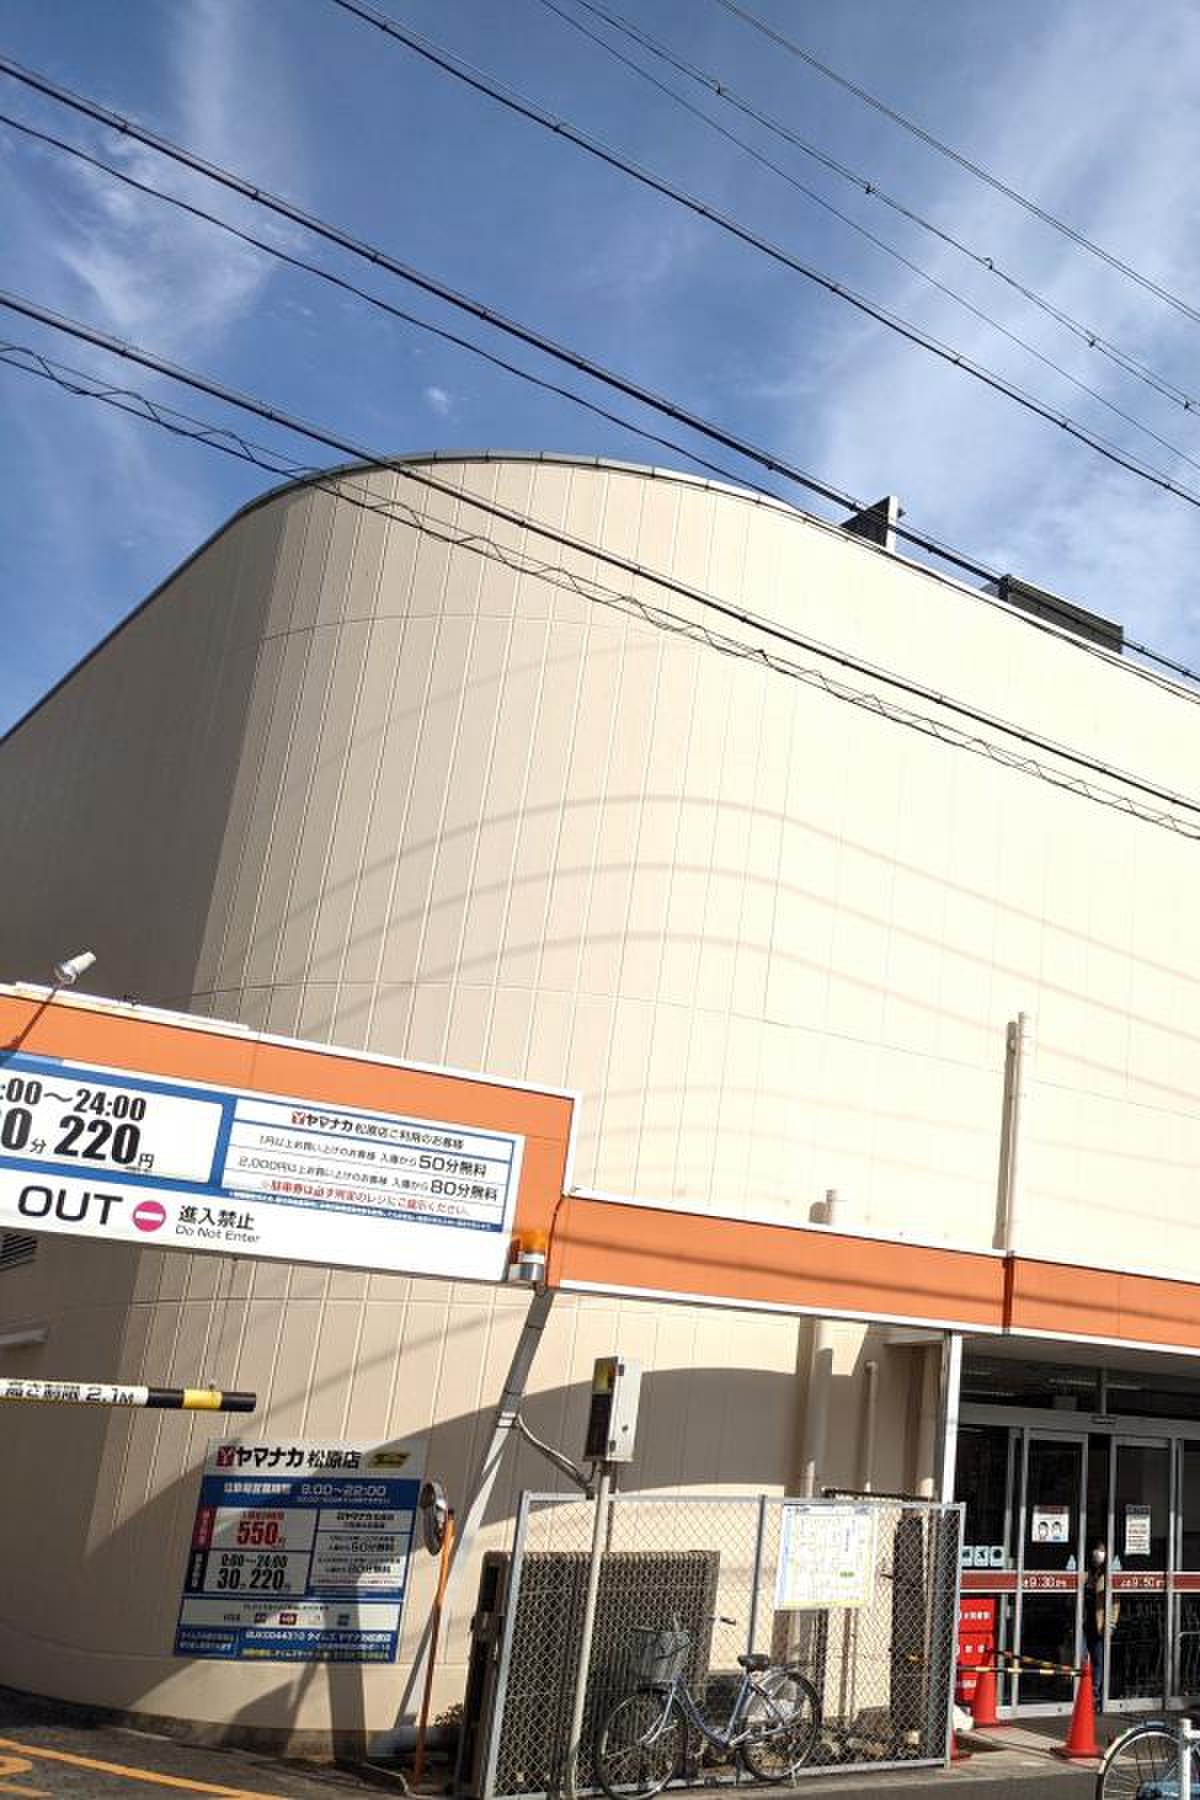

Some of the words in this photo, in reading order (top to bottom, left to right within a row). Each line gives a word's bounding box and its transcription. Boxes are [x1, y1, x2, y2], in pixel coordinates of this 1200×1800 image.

[305, 1112, 353, 1133] ヤマナカ
[53, 1115, 154, 1169] 220円
[18, 1185, 124, 1225] OUT
[178, 1204, 255, 1231] 進入禁止
[176, 1224, 194, 1236] Do
[197, 1227, 221, 1239] Not
[225, 1231, 260, 1243] Enter
[4, 1381, 81, 1400] 高さ制限
[86, 1386, 134, 1404] 2.1M
[236, 1446, 304, 1469] ヤマナカ
[306, 1449, 361, 1470] 松原店
